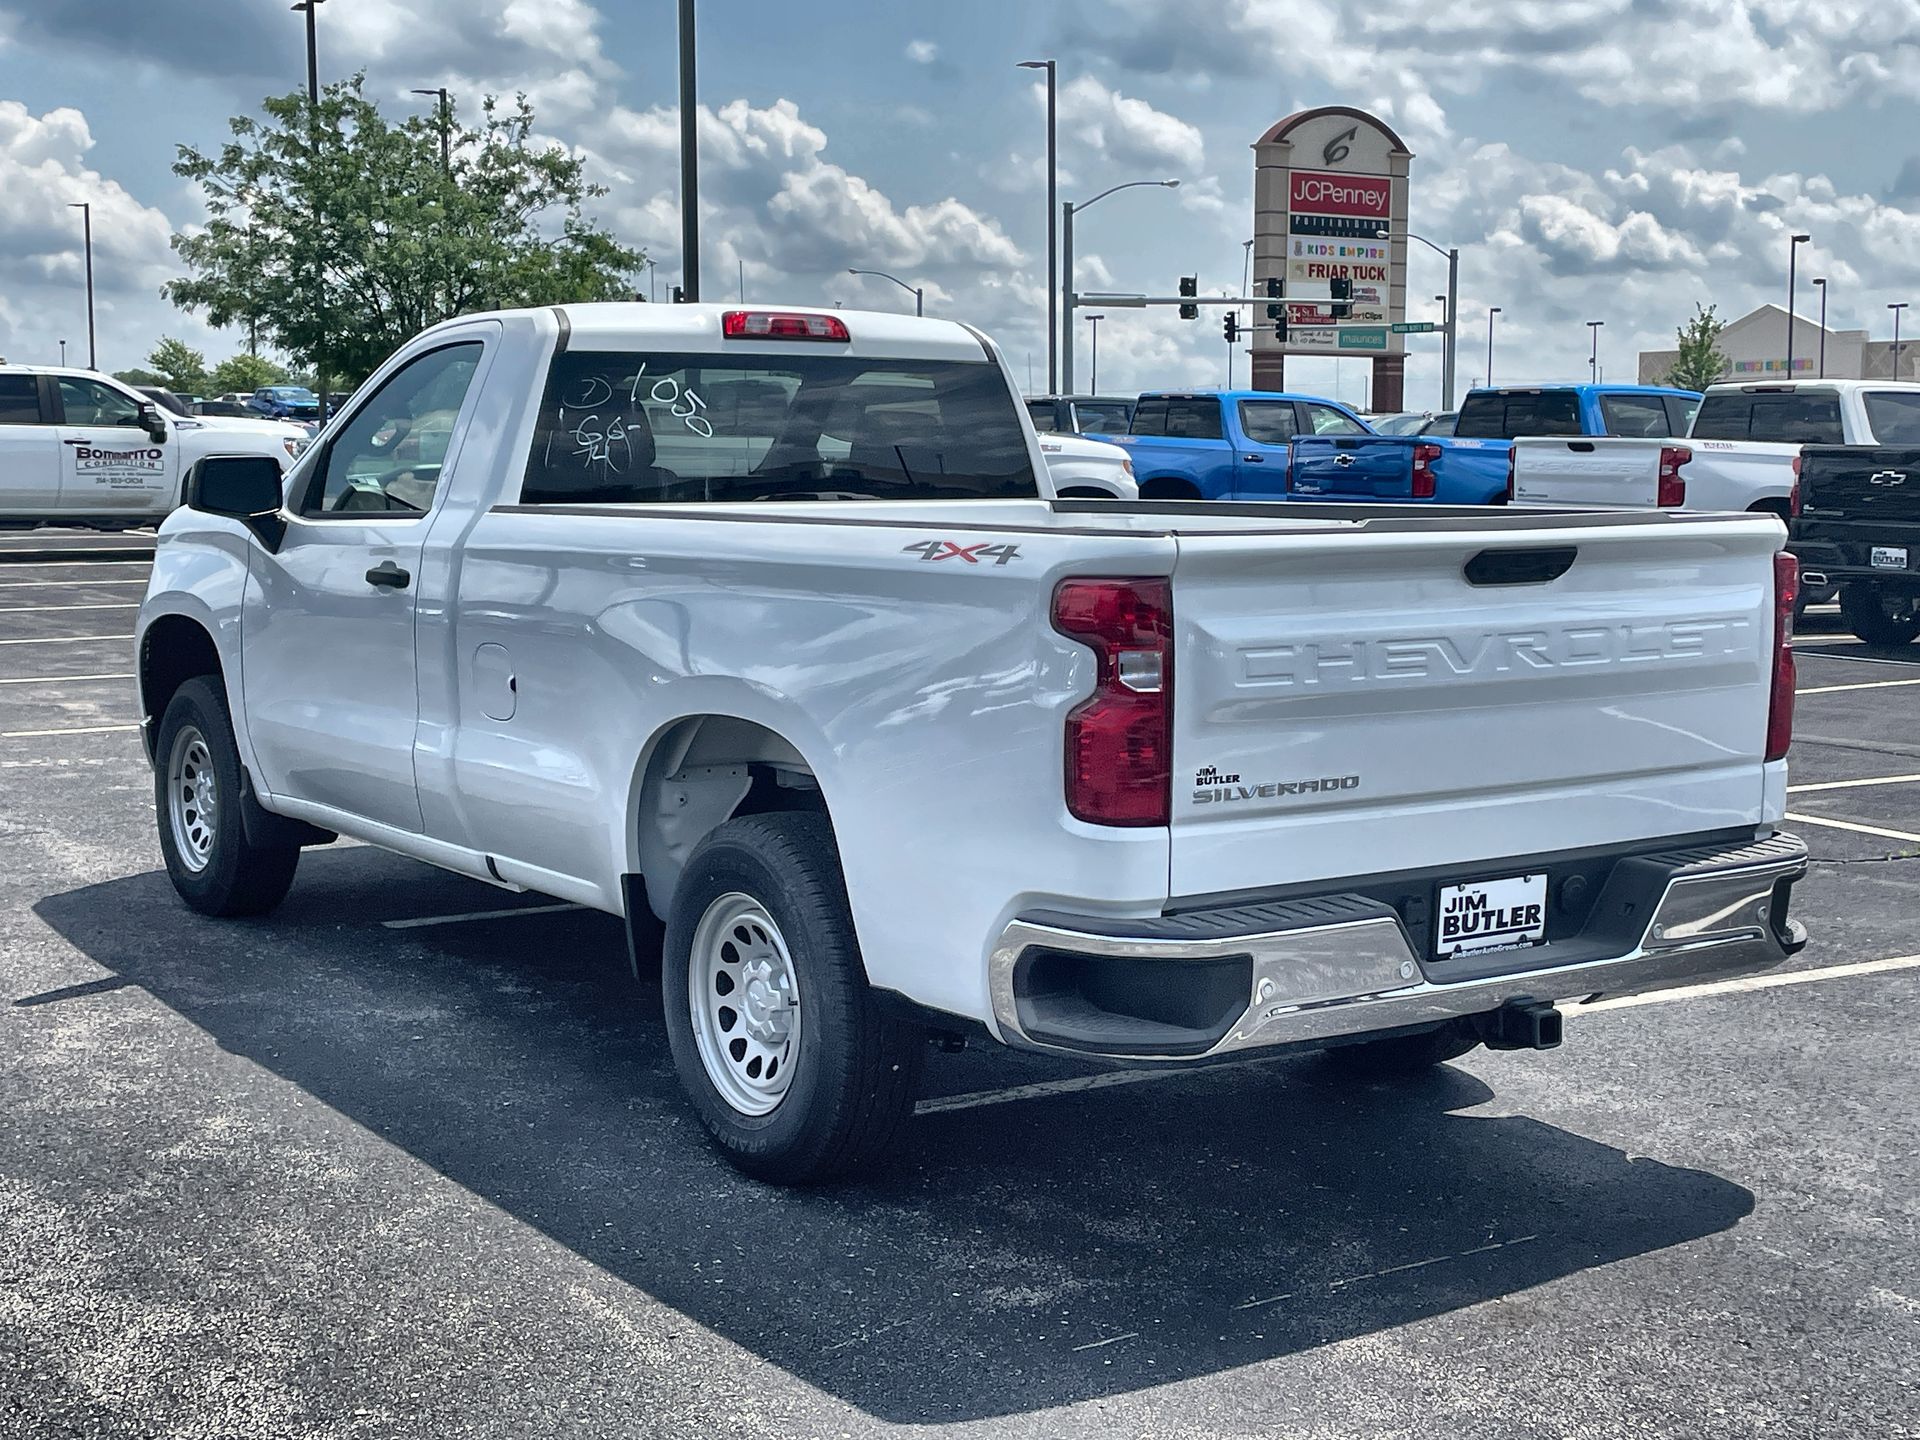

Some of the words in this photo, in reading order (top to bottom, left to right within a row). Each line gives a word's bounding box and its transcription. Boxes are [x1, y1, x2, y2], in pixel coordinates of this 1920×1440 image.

[1294, 180, 1387, 211] JCPenney
[1307, 244, 1335, 256] KIDS
[1339, 246, 1385, 259] EMPIRE
[1308, 263, 1349, 279] FRIAR
[1353, 265, 1386, 281] TUCK
[1235, 616, 1750, 688] CHEVROLET
[1196, 767, 1217, 777] JIM
[1196, 775, 1240, 786] BUTLER
[1192, 775, 1360, 804] SILVERADO
[1444, 893, 1488, 913] JIM
[1443, 904, 1541, 937] BUTLER
